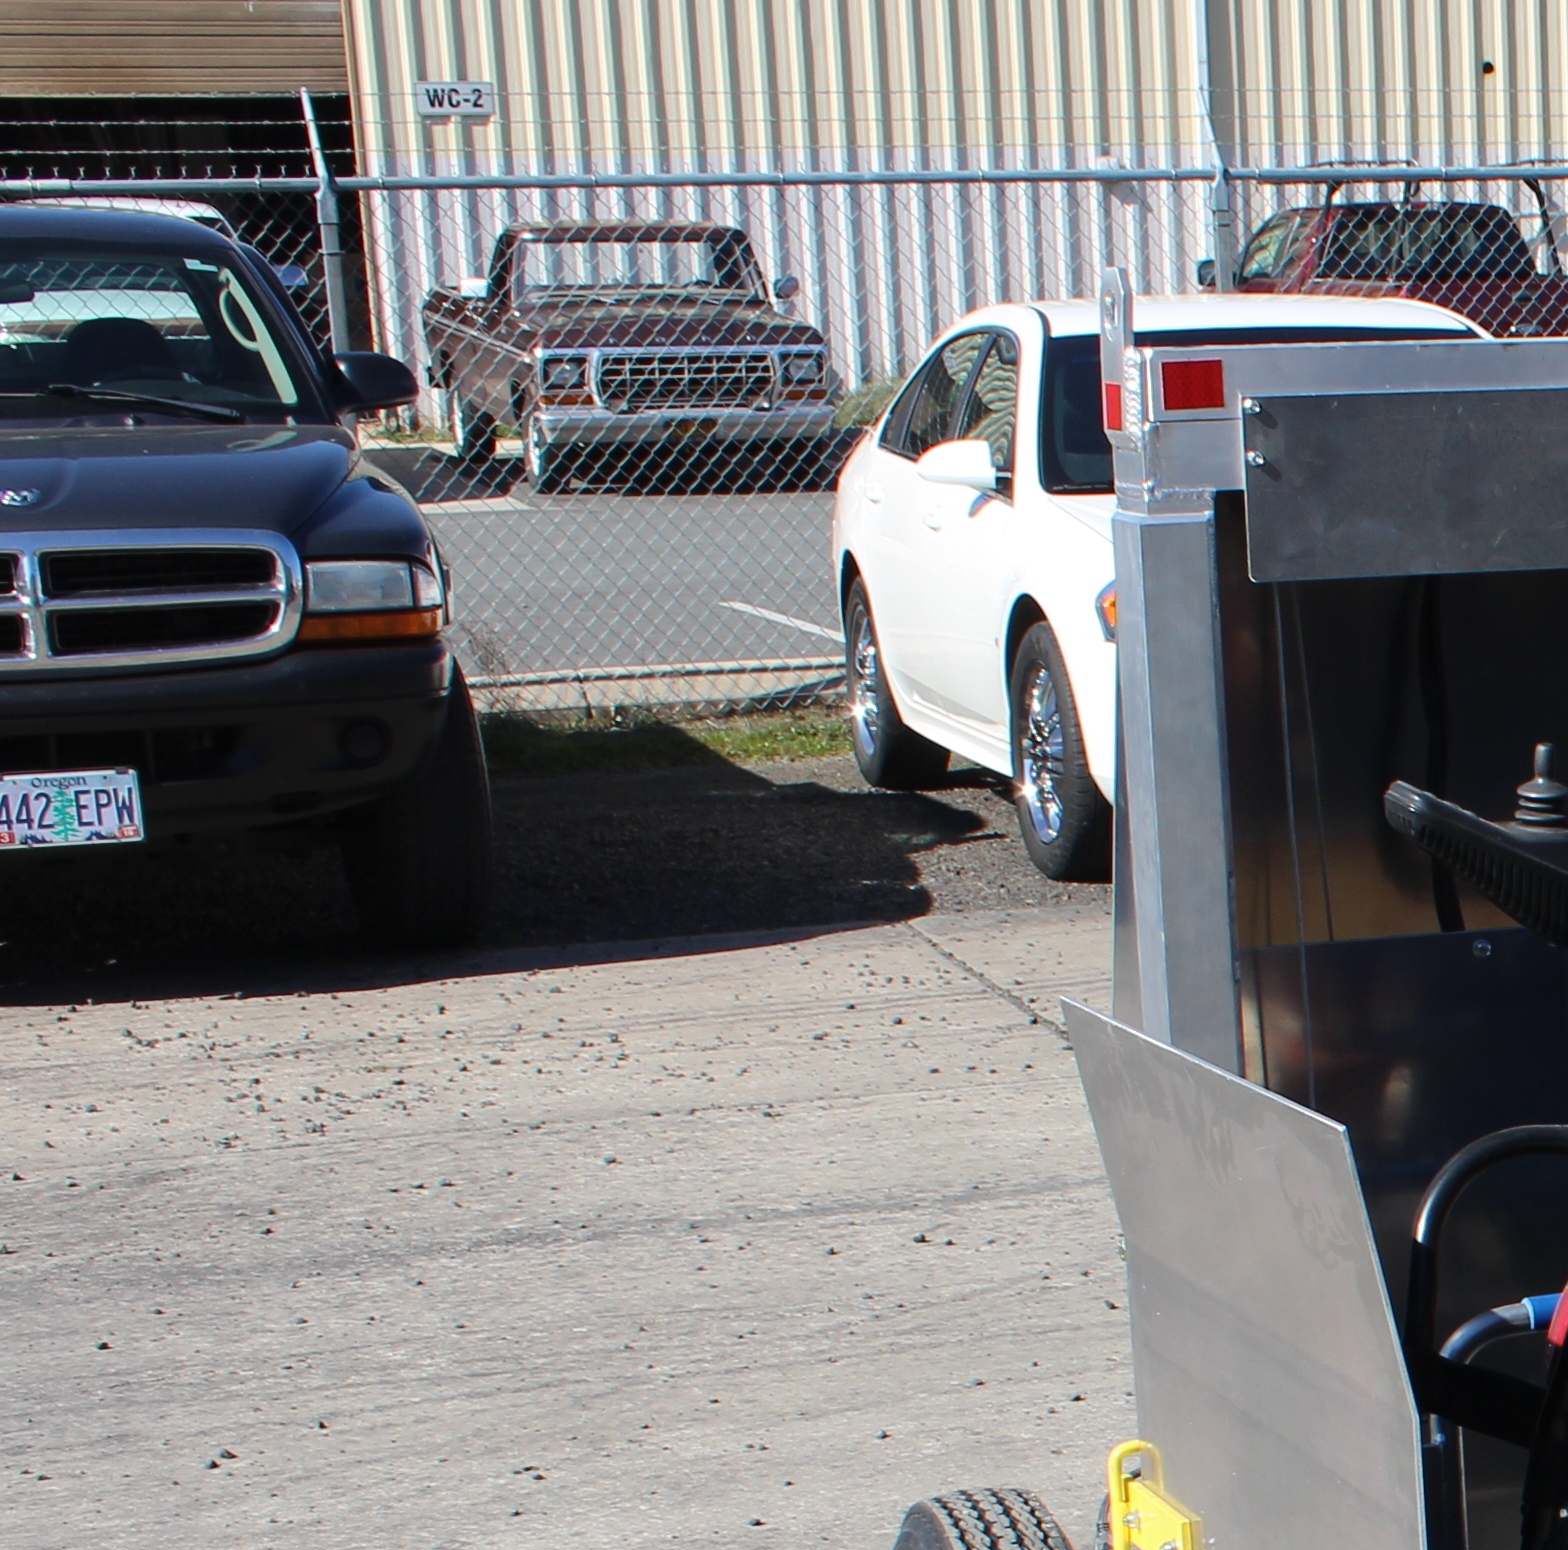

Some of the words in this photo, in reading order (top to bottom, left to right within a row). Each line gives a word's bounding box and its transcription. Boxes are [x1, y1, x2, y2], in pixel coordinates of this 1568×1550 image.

[424, 88, 484, 108] WC-2
[31, 776, 87, 789] Oregon
[0, 792, 56, 831] 442
[73, 786, 135, 828] EPW
